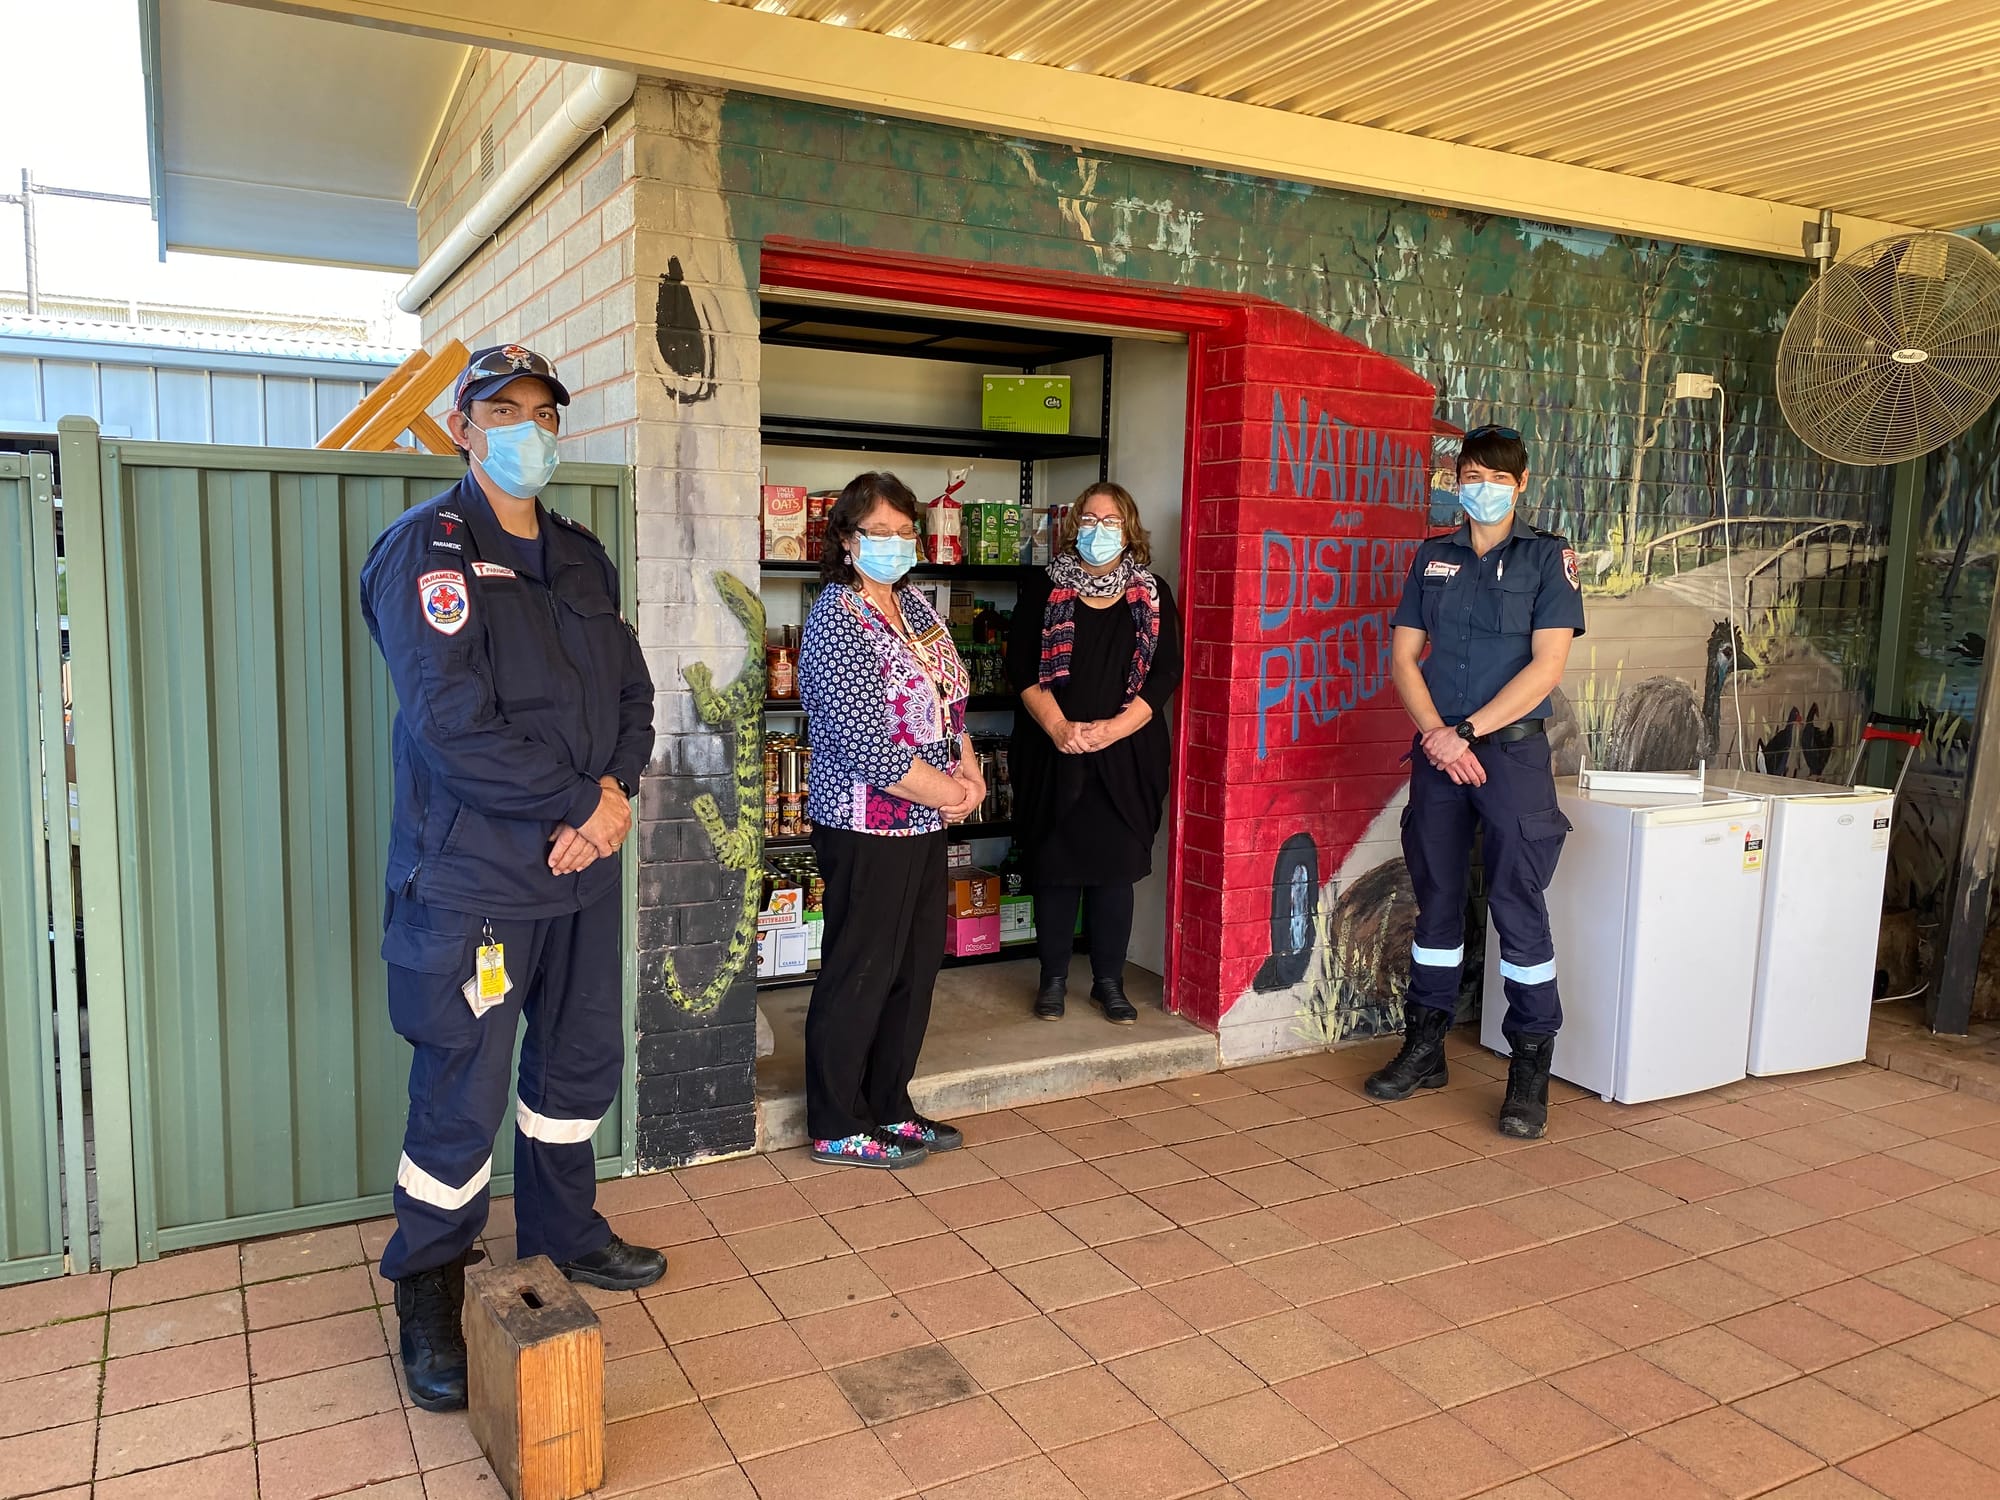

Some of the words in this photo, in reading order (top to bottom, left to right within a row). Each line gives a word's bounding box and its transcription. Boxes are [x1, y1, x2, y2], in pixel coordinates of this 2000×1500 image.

[1269, 390, 1425, 512] NATHALIA
[771, 498, 799, 510] OATS
[433, 541, 461, 550] PARAMEDIC
[421, 573, 461, 586] PARAMEDIC
[1257, 608, 1394, 761] PRESCH
